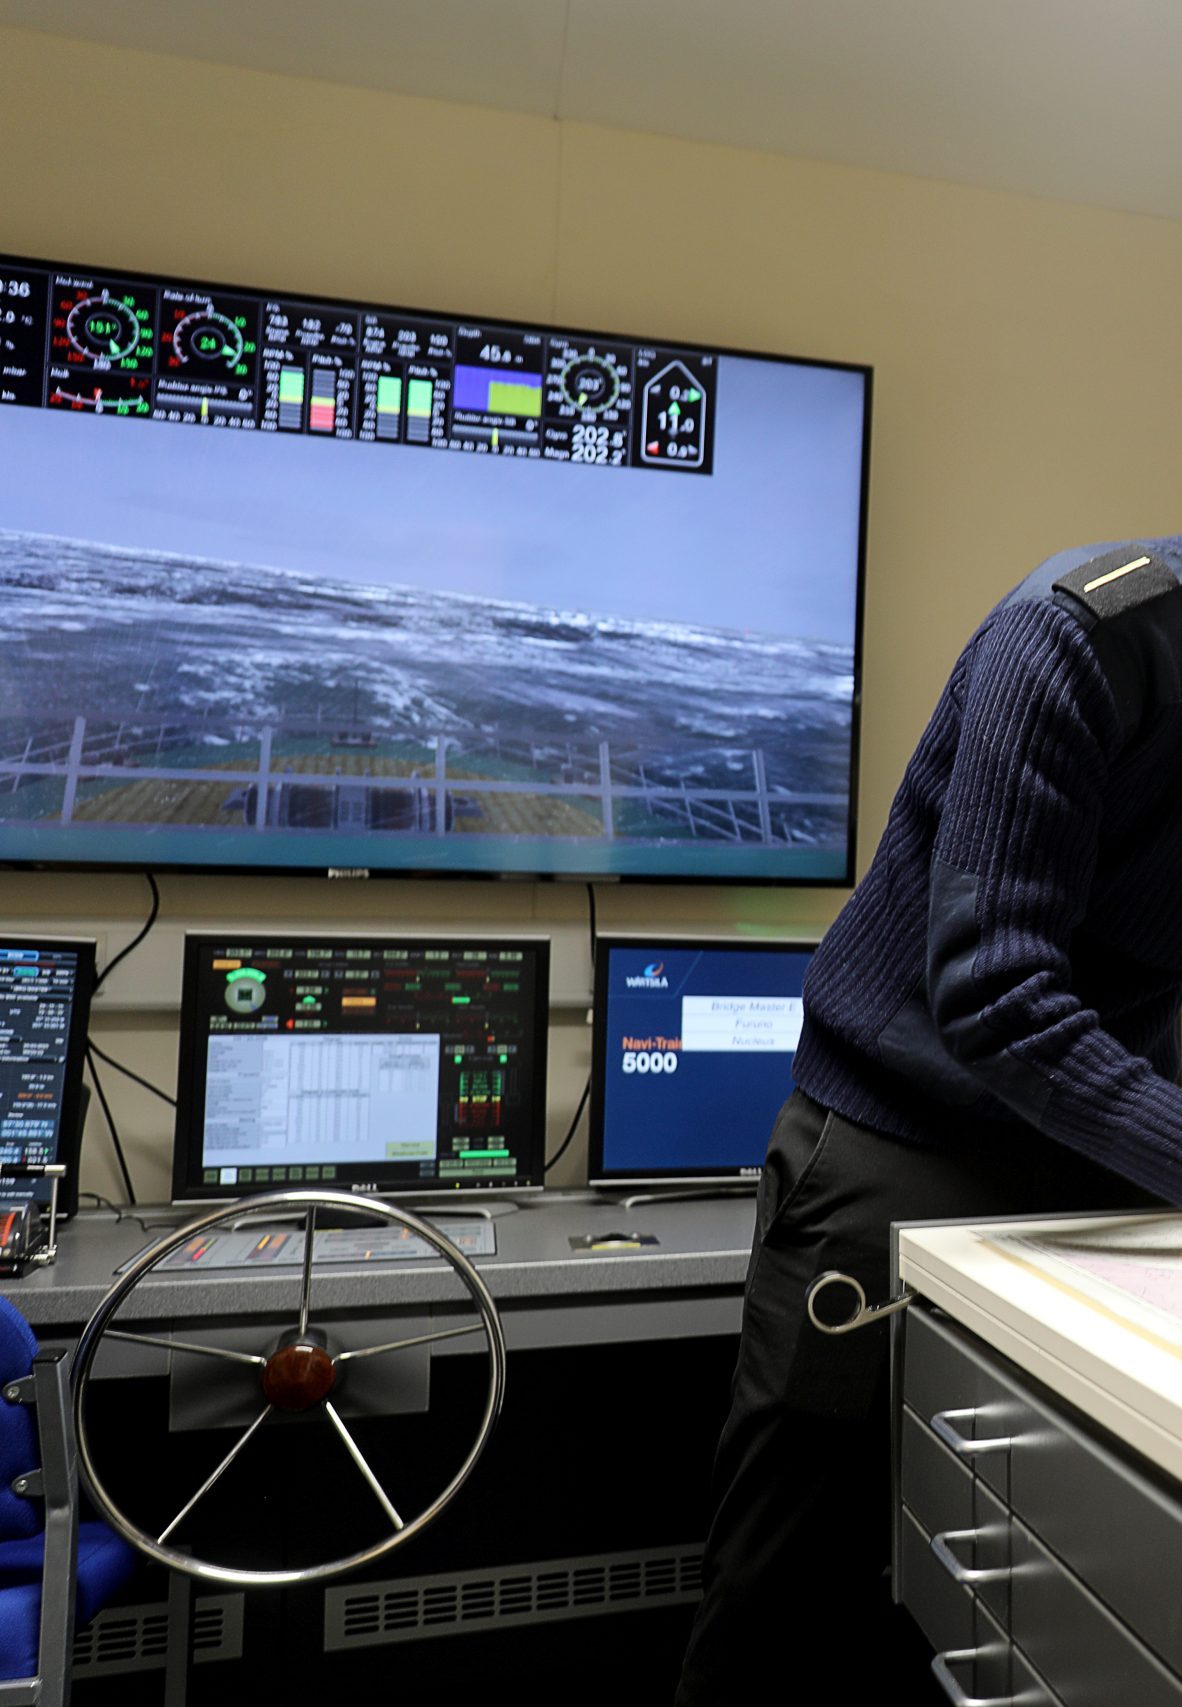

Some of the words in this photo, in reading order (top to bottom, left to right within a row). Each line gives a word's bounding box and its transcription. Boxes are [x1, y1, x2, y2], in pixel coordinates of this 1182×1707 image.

[711, 1001, 747, 1015] Bridge
[749, 1001, 786, 1012] Master
[735, 1018, 774, 1029] Furuno
[731, 1036, 776, 1046] Nucleus
[622, 1051, 678, 1074] 5000
